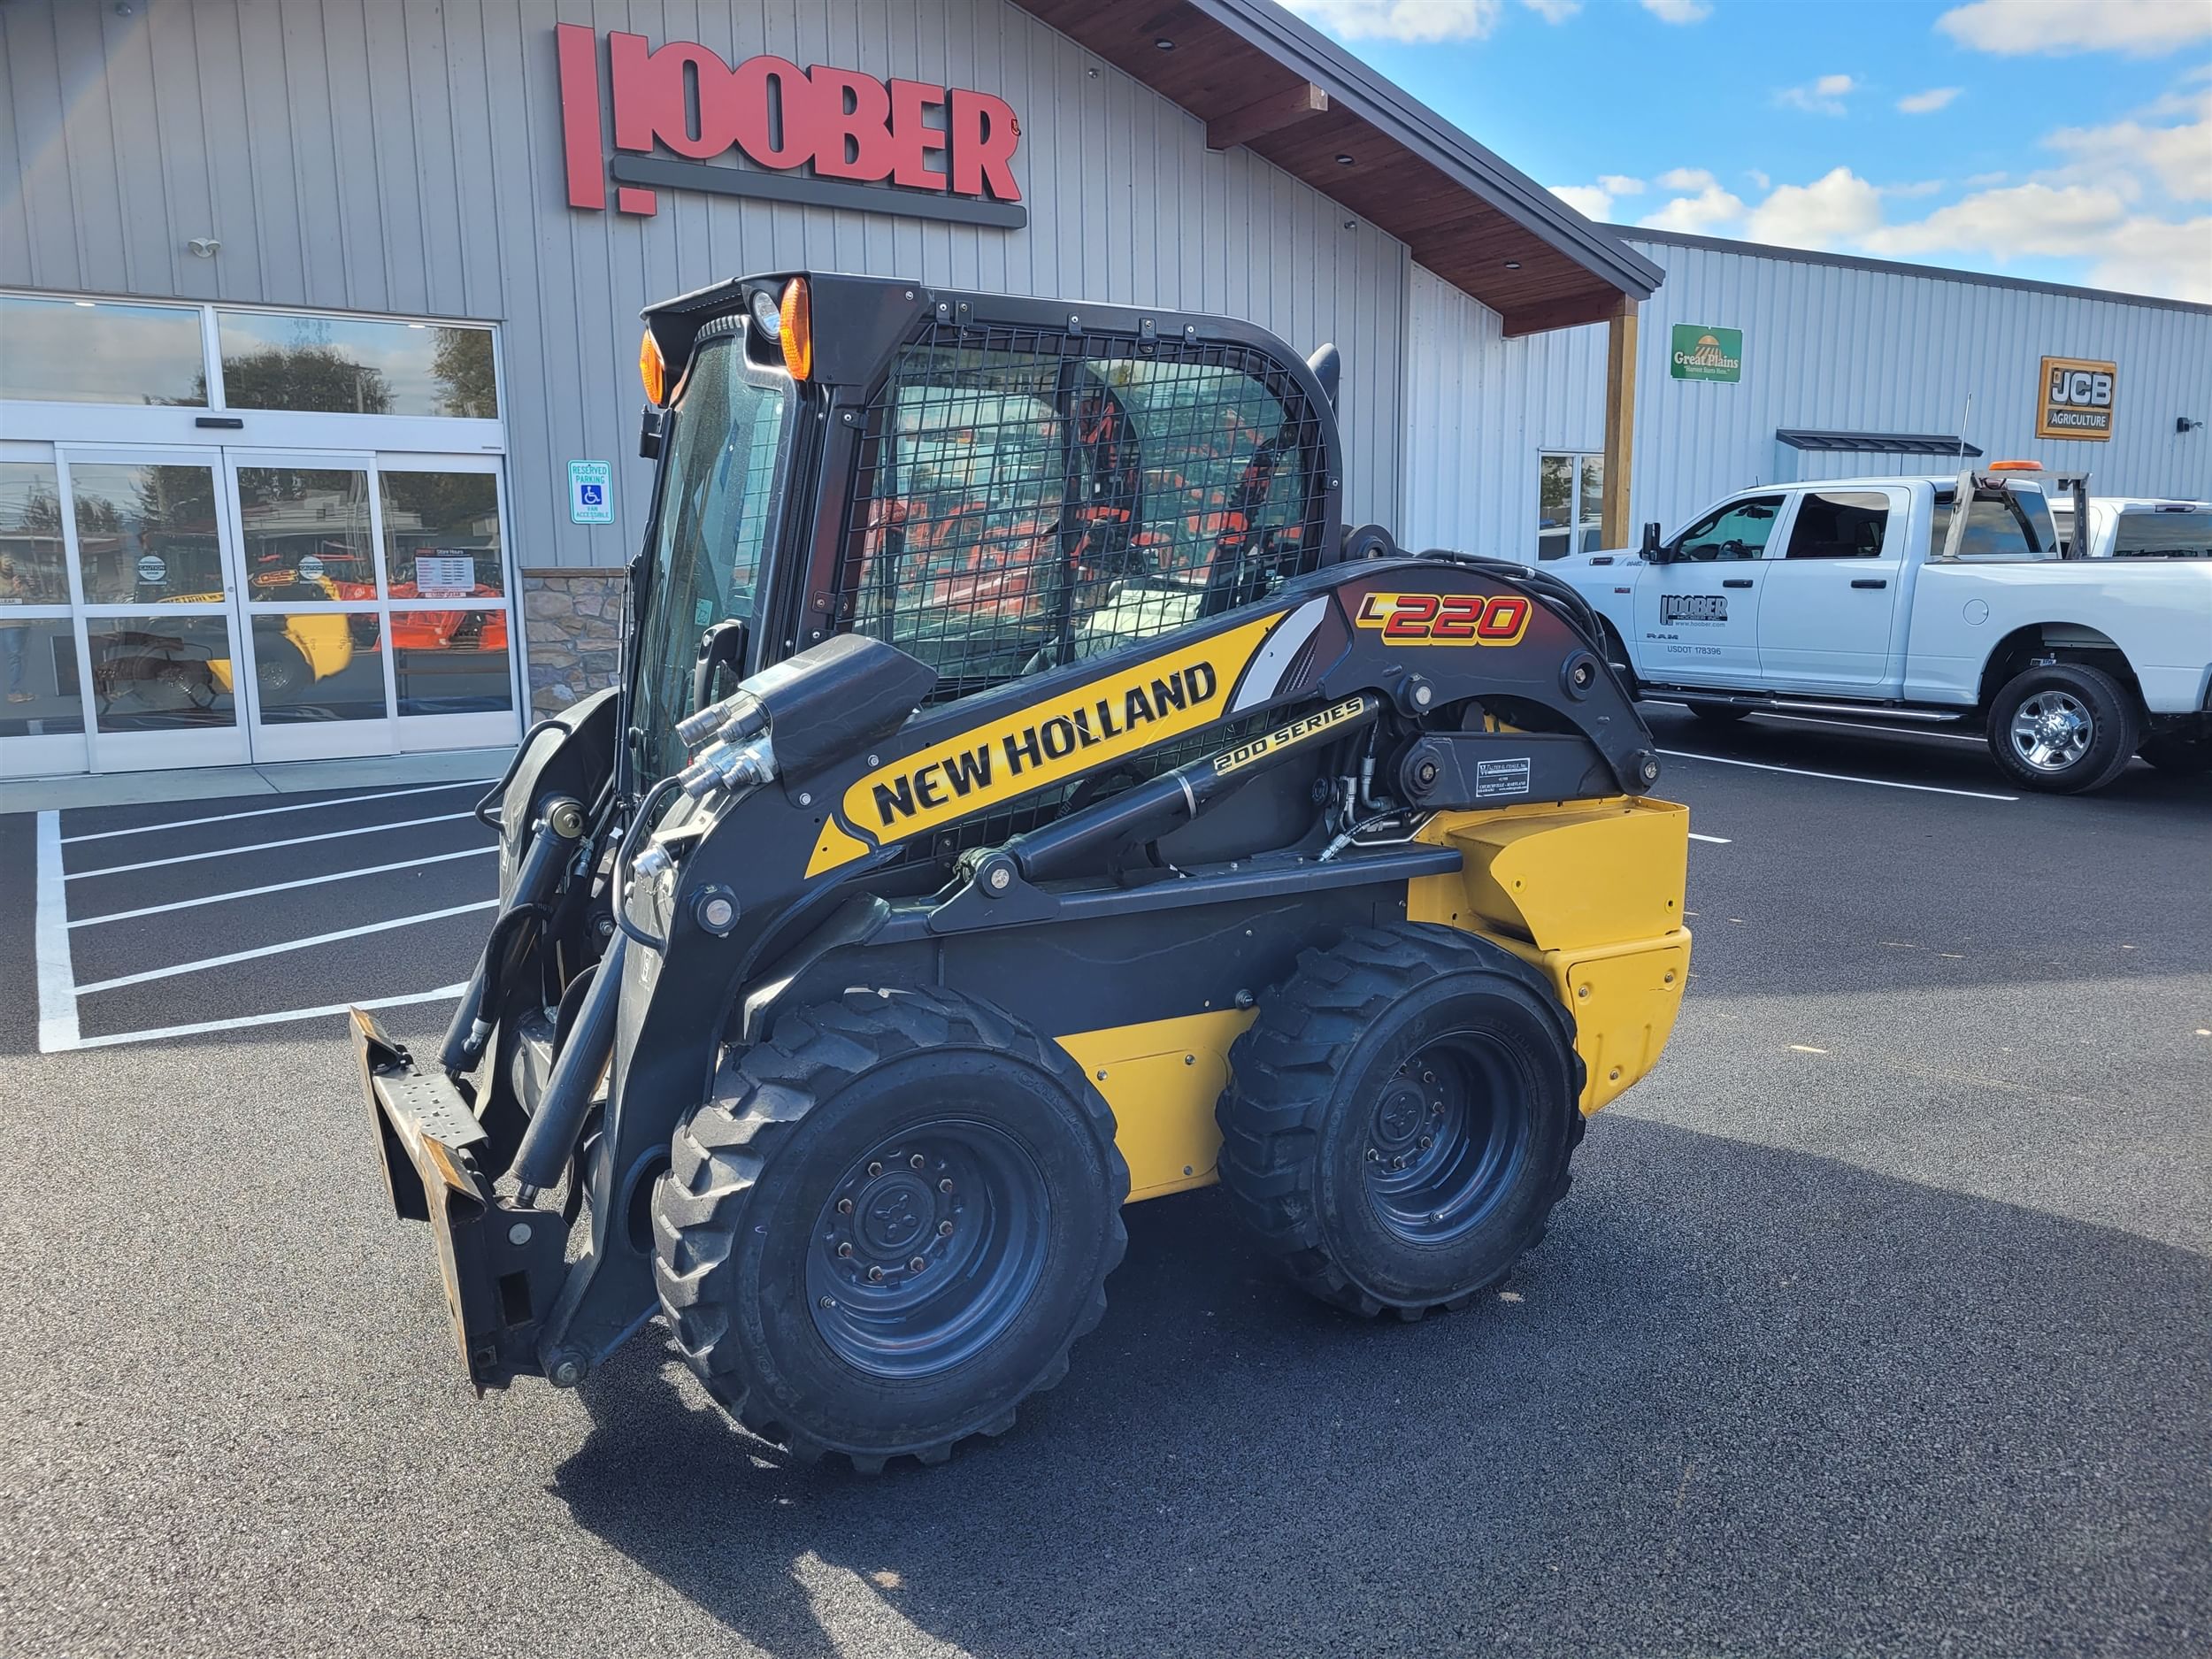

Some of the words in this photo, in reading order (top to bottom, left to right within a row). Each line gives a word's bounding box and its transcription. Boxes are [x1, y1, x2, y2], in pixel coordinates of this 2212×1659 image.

[556, 22, 1021, 217] HOOBER
[1674, 351, 1706, 365] Great
[1708, 354, 1739, 368] Plains
[2052, 372, 2112, 405] JCB
[2051, 412, 2106, 426] AGRICULTURE
[572, 465, 607, 475] RESERVED
[576, 475, 605, 484] PARKING
[1357, 593, 1532, 645] L220
[1660, 595, 1728, 626] HOOBER
[1667, 645, 1692, 654] USDOT
[1695, 647, 1721, 656] 178396
[872, 743, 993, 827] NEW
[1002, 660, 1218, 776] HOLLAND
[1215, 739, 1267, 771] 200
[1274, 698, 1361, 746] SERIES
